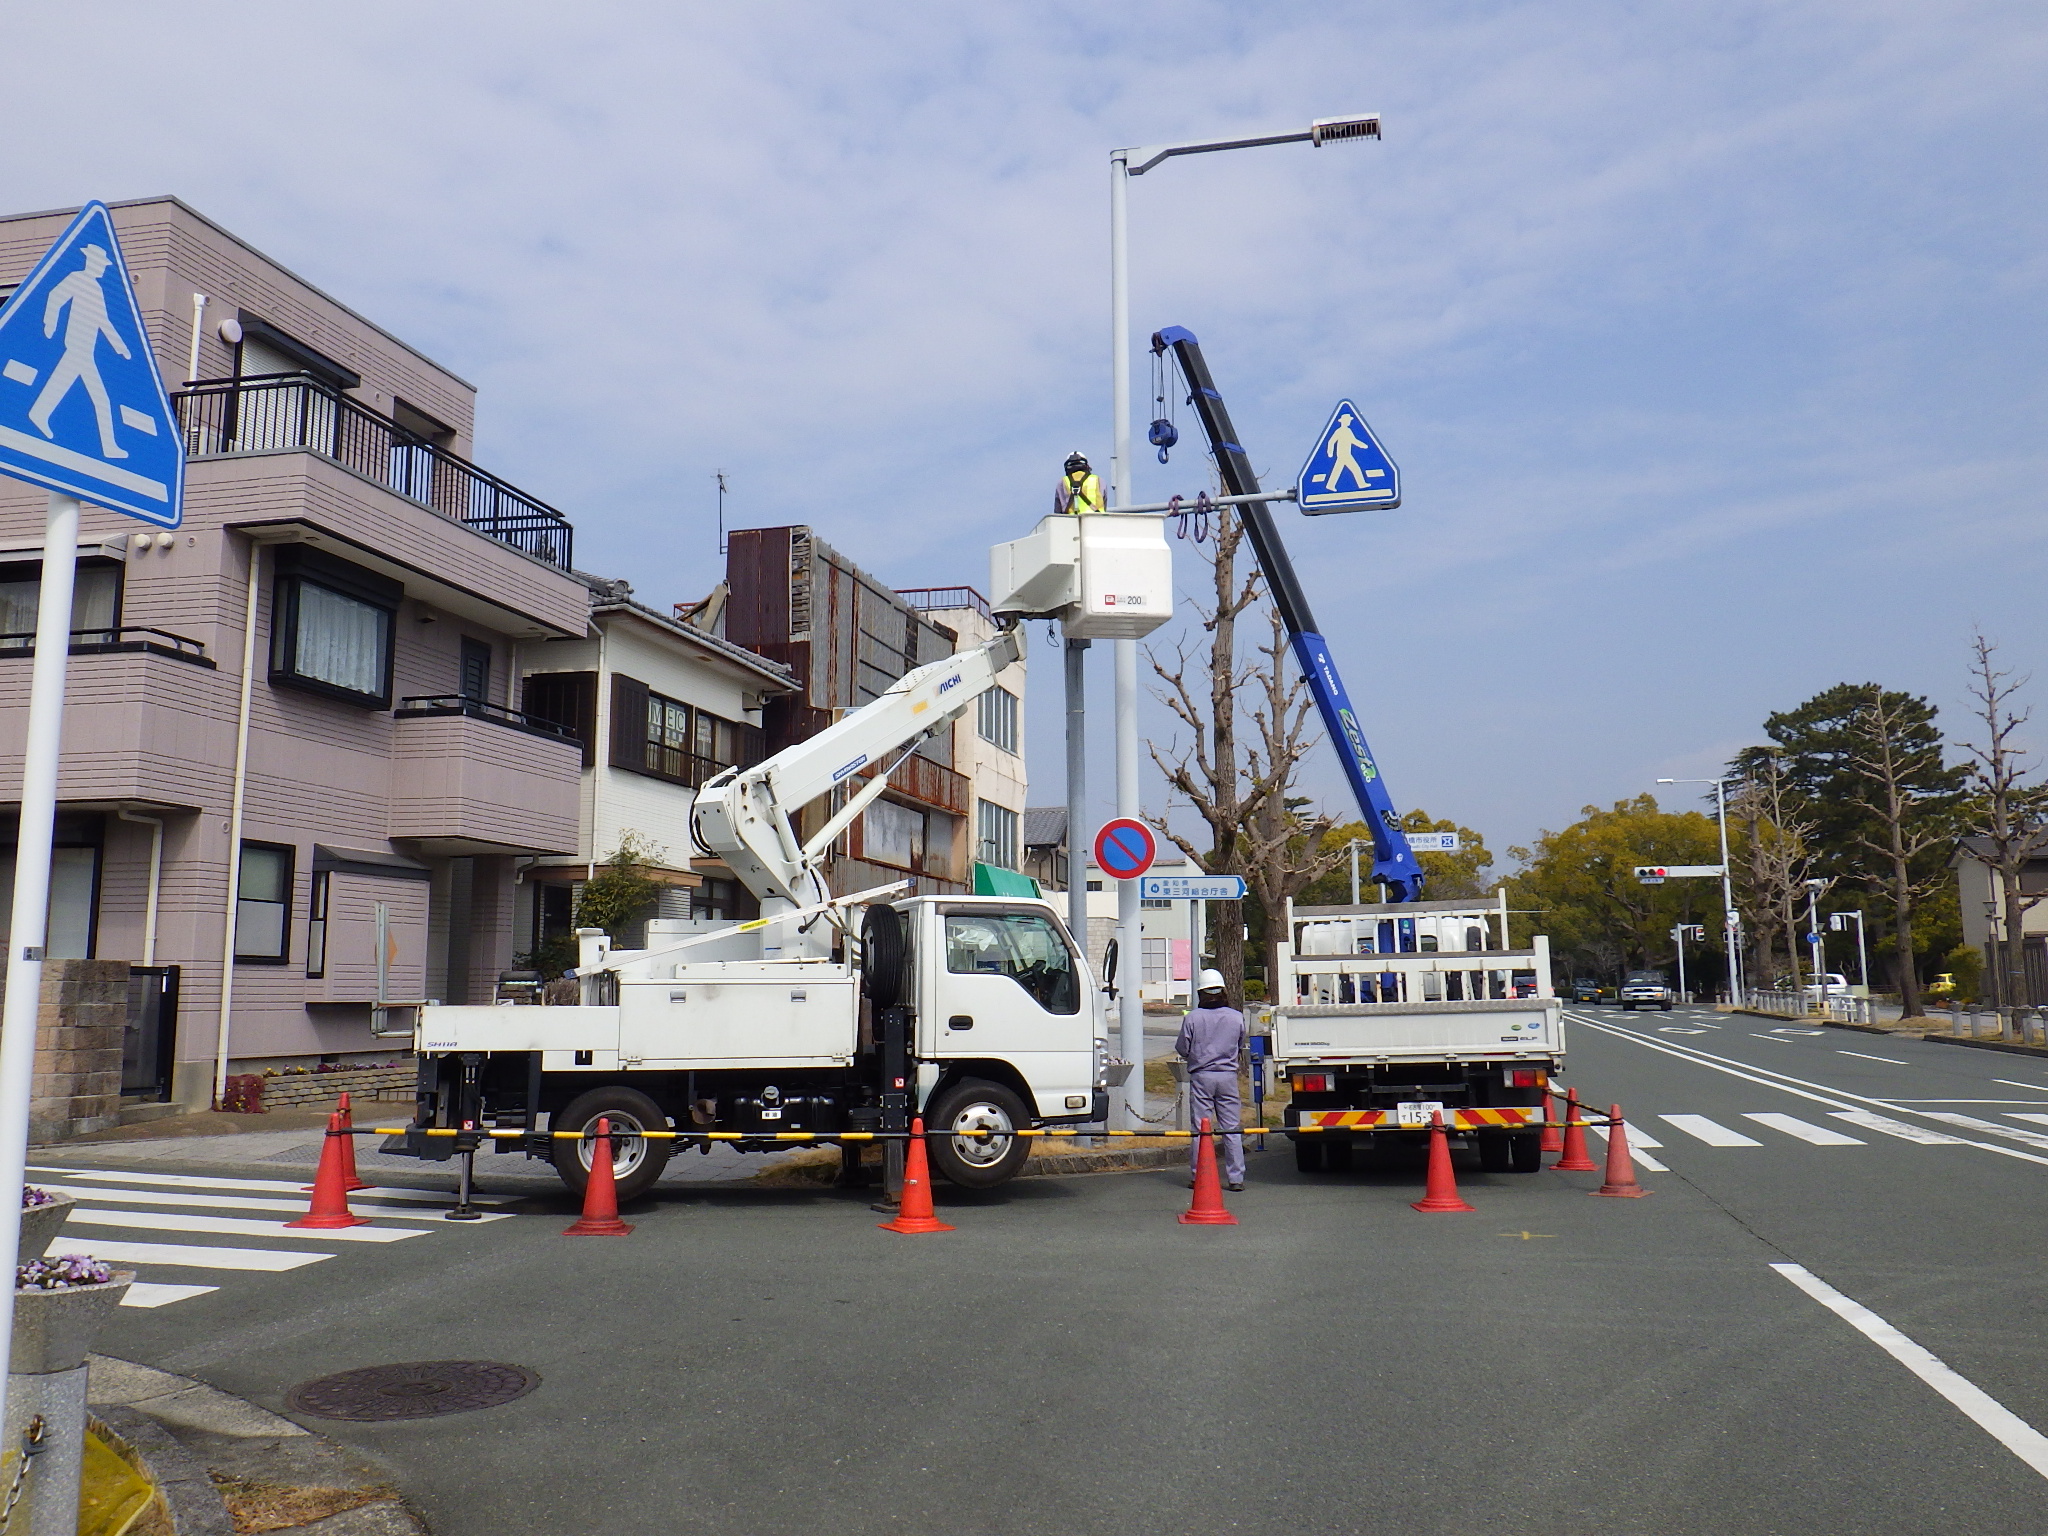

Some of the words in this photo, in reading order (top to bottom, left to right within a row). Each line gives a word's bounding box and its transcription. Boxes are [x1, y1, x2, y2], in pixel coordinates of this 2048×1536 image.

[1127, 595, 1142, 605] 200
[939, 673, 962, 695] AICHI
[1323, 665, 1339, 696] TADANO
[1339, 709, 1374, 768] Zest
[1408, 836, 1438, 844] 橋市役所
[1162, 887, 1229, 897] 東三河総合庁舎
